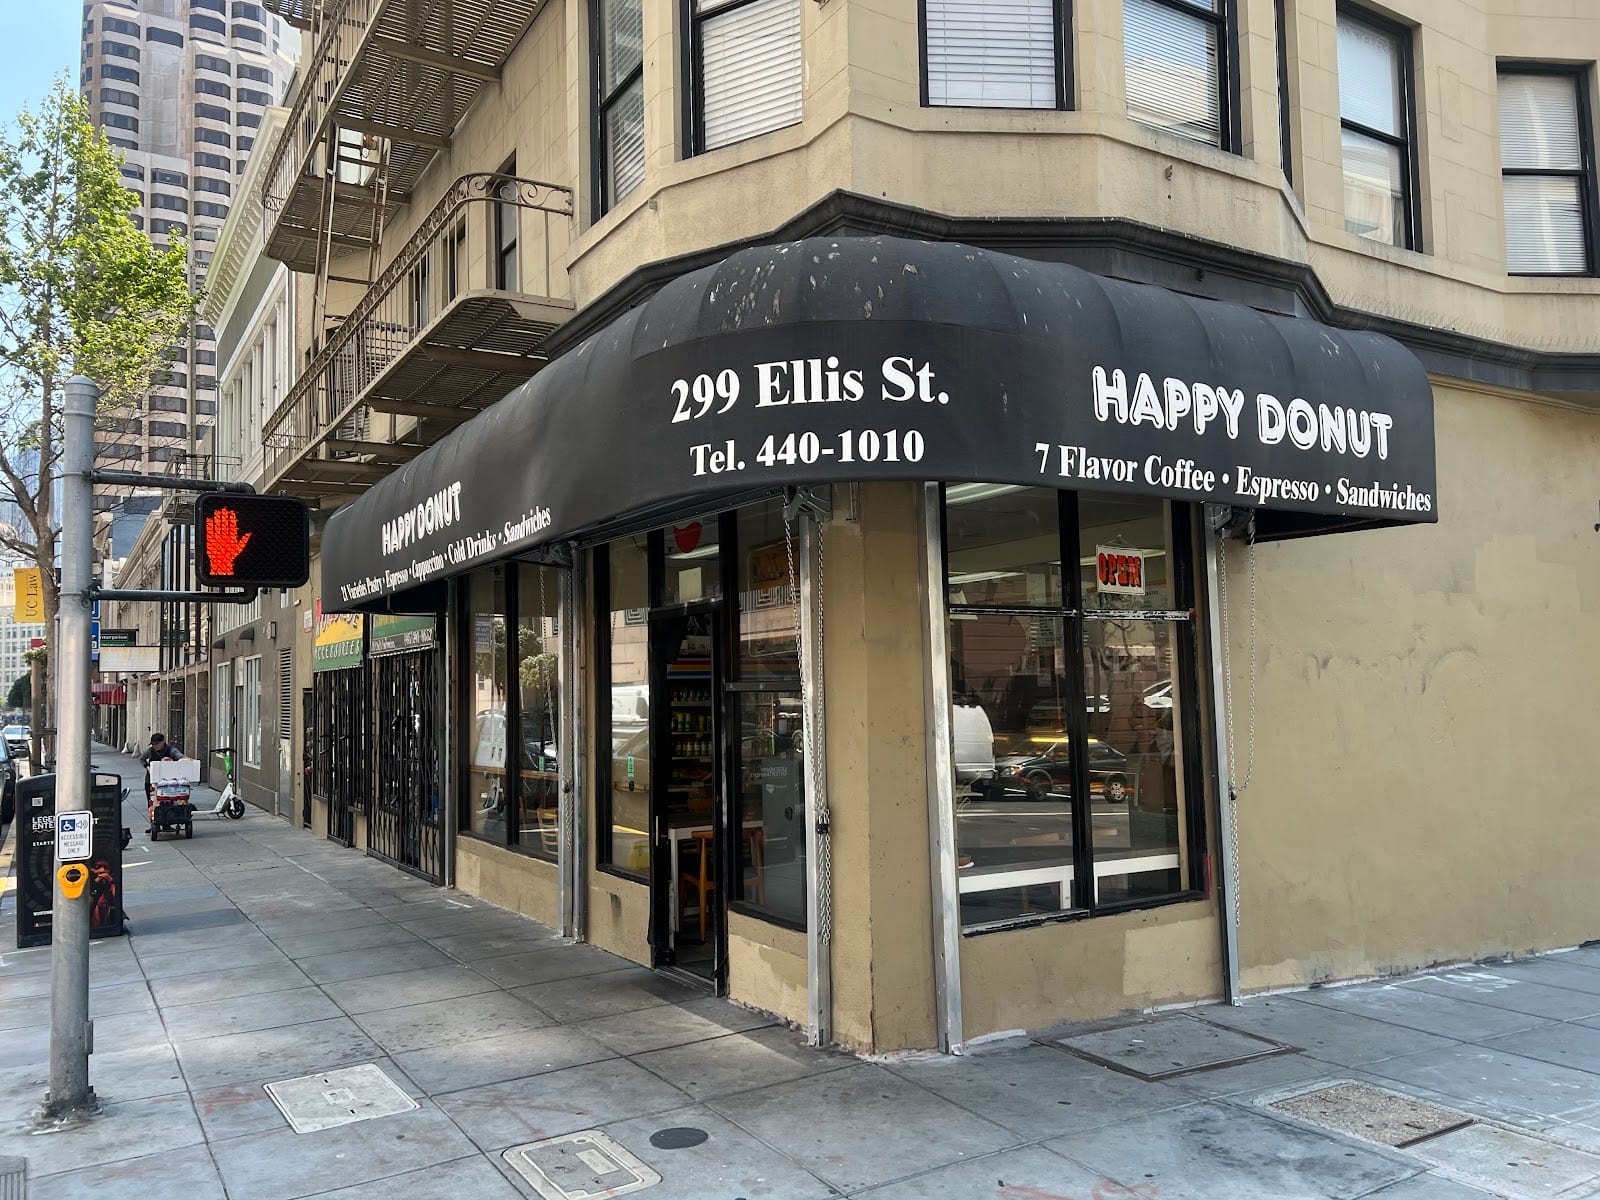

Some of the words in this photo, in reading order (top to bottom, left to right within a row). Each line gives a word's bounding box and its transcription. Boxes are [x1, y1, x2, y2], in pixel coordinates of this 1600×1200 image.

[670, 368, 740, 424] 299
[753, 356, 864, 408] Ellis
[881, 356, 950, 404] St.
[1092, 365, 1245, 440] HAPPY
[1256, 393, 1393, 461] DONUT
[689, 440, 746, 476] Tel.
[756, 429, 925, 467] 440-1010
[1035, 442, 1050, 474] 7
[1057, 445, 1138, 483] Flavor
[1144, 454, 1216, 492] Coffee
[1235, 466, 1320, 505] Espresso
[1336, 478, 1432, 512] Sandwiches
[346, 579, 367, 600] Varieties
[366, 576, 383, 596] Pastry
[385, 568, 409, 592] Espresso
[411, 551, 445, 582] Cappuccino
[447, 539, 465, 565] Cold
[465, 529, 497, 559] Drinks
[503, 506, 552, 545] Sandwiches
[381, 512, 416, 557] HAPPY
[416, 481, 462, 540] DONUT
[26, 574, 38, 596] Law
[1097, 551, 1142, 588] OPEN
[26, 600, 38, 617] UC
